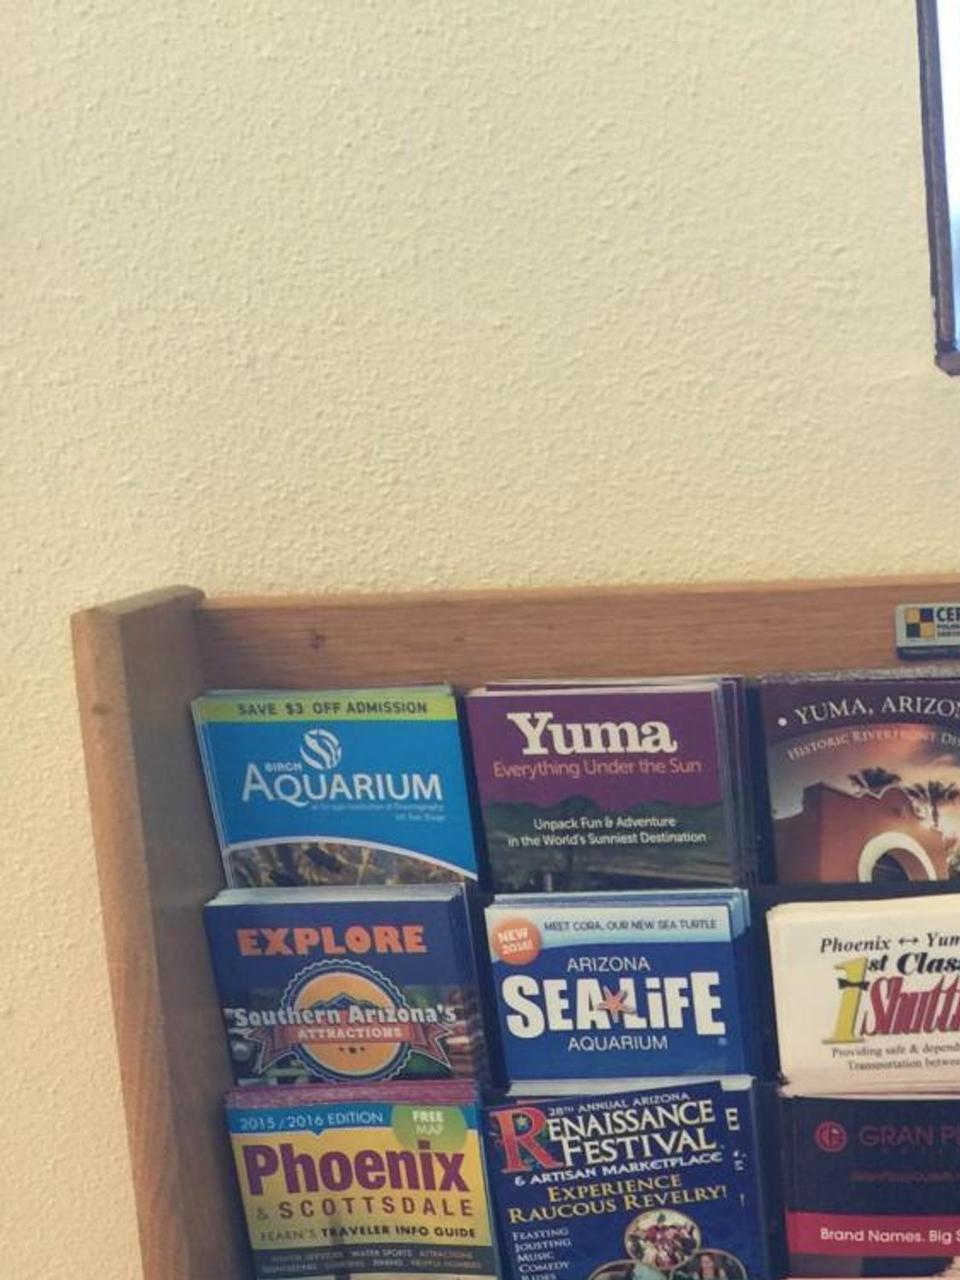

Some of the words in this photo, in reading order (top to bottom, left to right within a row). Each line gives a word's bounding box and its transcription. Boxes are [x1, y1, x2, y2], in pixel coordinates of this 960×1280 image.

[238, 703, 277, 717] SAVE
[312, 702, 343, 716] OFF
[347, 700, 428, 716] ADMISSION
[507, 712, 679, 757] Yuma
[494, 761, 580, 782] Everything
[583, 759, 633, 777] Under
[638, 758, 665, 775] the
[670, 758, 703, 775] Sun
[242, 763, 444, 808] AQUARIUM
[533, 818, 578, 833] Unpack
[617, 816, 677, 830] Adventure
[639, 829, 707, 846] Destination
[657, 920, 678, 931] SEA
[235, 925, 428, 957] EXPLORE
[820, 936, 891, 954] Phoenix
[567, 957, 652, 973] ARIZONA
[234, 1004, 343, 1027] Southern
[348, 1003, 457, 1025] Arizona's
[501, 975, 611, 1039] SEA
[296, 1025, 404, 1040] ATTRACTIONS
[568, 1036, 669, 1051] AQUARIUM
[831, 1045, 883, 1061] Providing
[633, 1091, 691, 1108] ARIZONA
[326, 1110, 384, 1127] EDITION
[411, 1110, 445, 1124] FREE
[560, 1129, 717, 1170] FESTIVAL
[241, 1140, 471, 1196] Phoenix
[547, 1173, 682, 1203] EXPERIENCE
[279, 1196, 475, 1219] SCOTTSDALE
[507, 1198, 620, 1224] RAUCOUS
[321, 1224, 391, 1239] TRAVELER
[394, 1224, 430, 1238] INFO
[433, 1225, 477, 1239] GUIDE
[512, 1227, 569, 1242] FEASTING
[820, 1228, 865, 1242] Brand
[929, 1228, 953, 1245] Big
[518, 1262, 569, 1275] COMEDY
